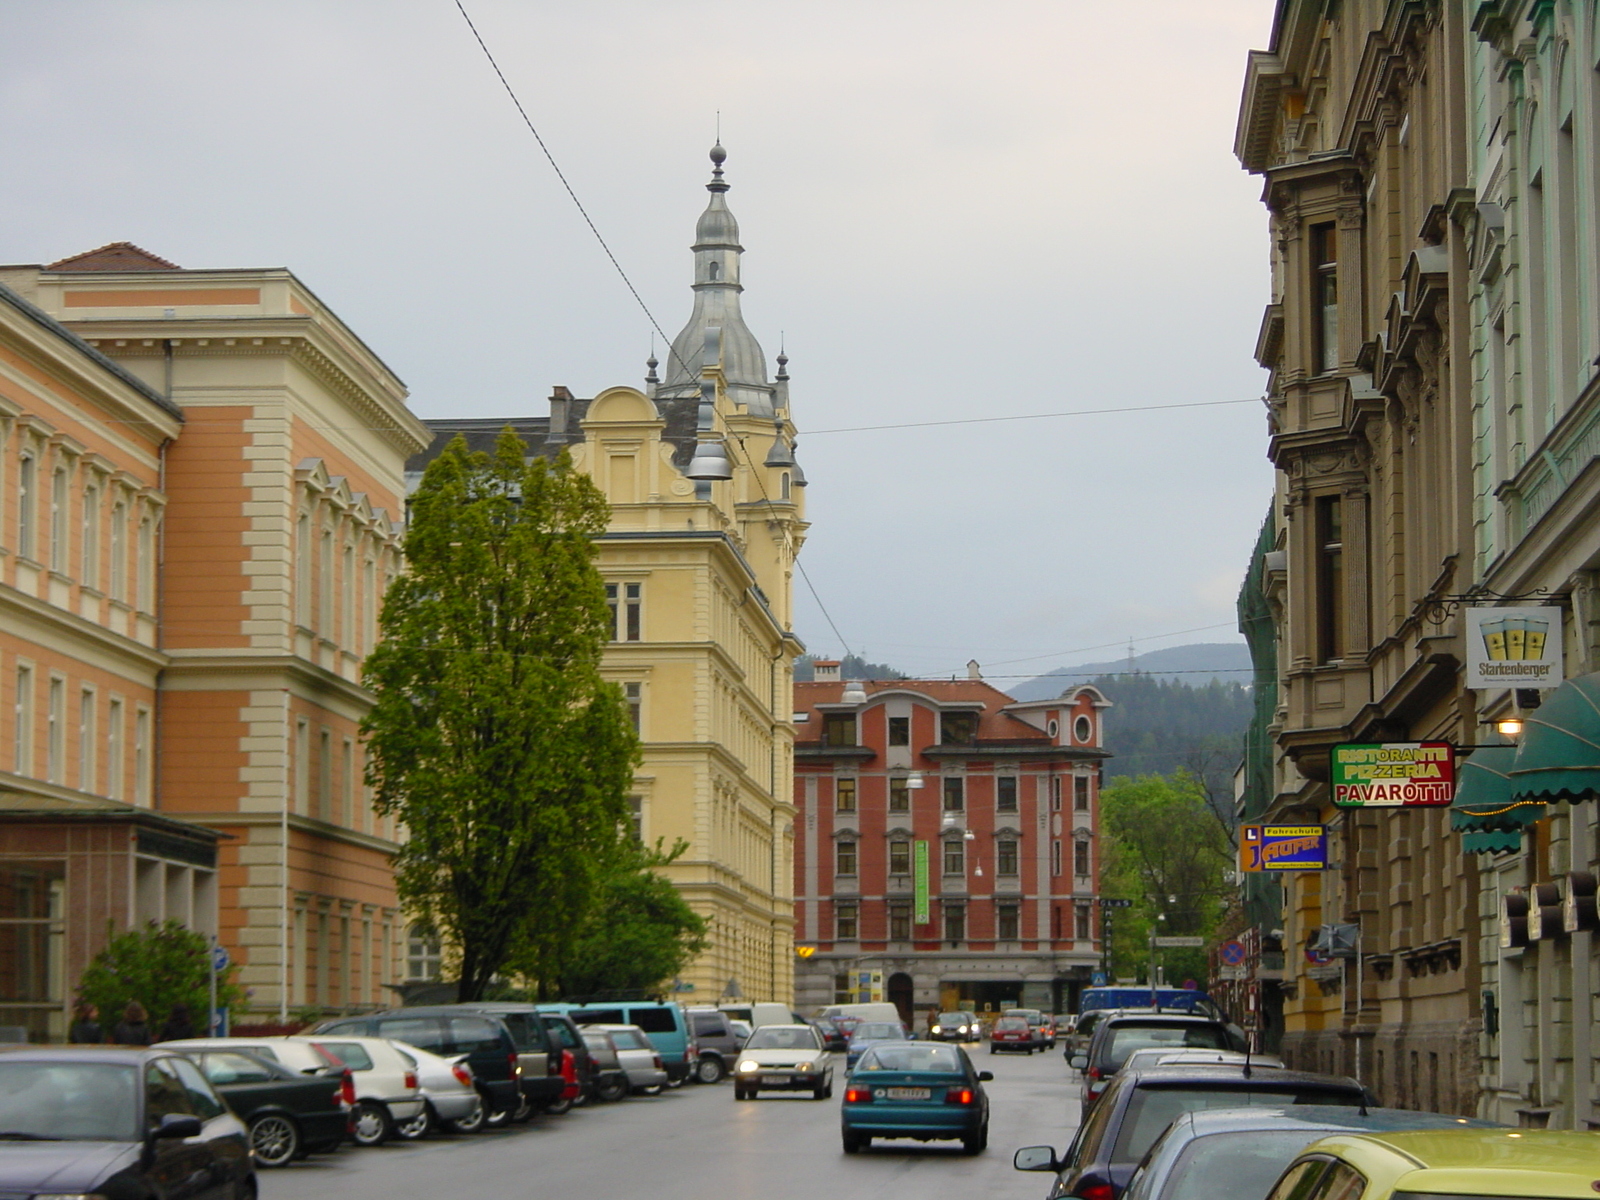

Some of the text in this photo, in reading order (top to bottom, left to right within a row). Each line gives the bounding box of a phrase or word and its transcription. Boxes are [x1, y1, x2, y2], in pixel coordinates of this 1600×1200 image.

[1478, 662, 1551, 677] Starkenberger
[1337, 748, 1448, 763] RISTORANTE
[1344, 763, 1442, 779] PIZZERIA
[1335, 782, 1452, 802] PAVAROTTI
[1247, 829, 1257, 840] L
[1100, 899, 1129, 907] GLAS
